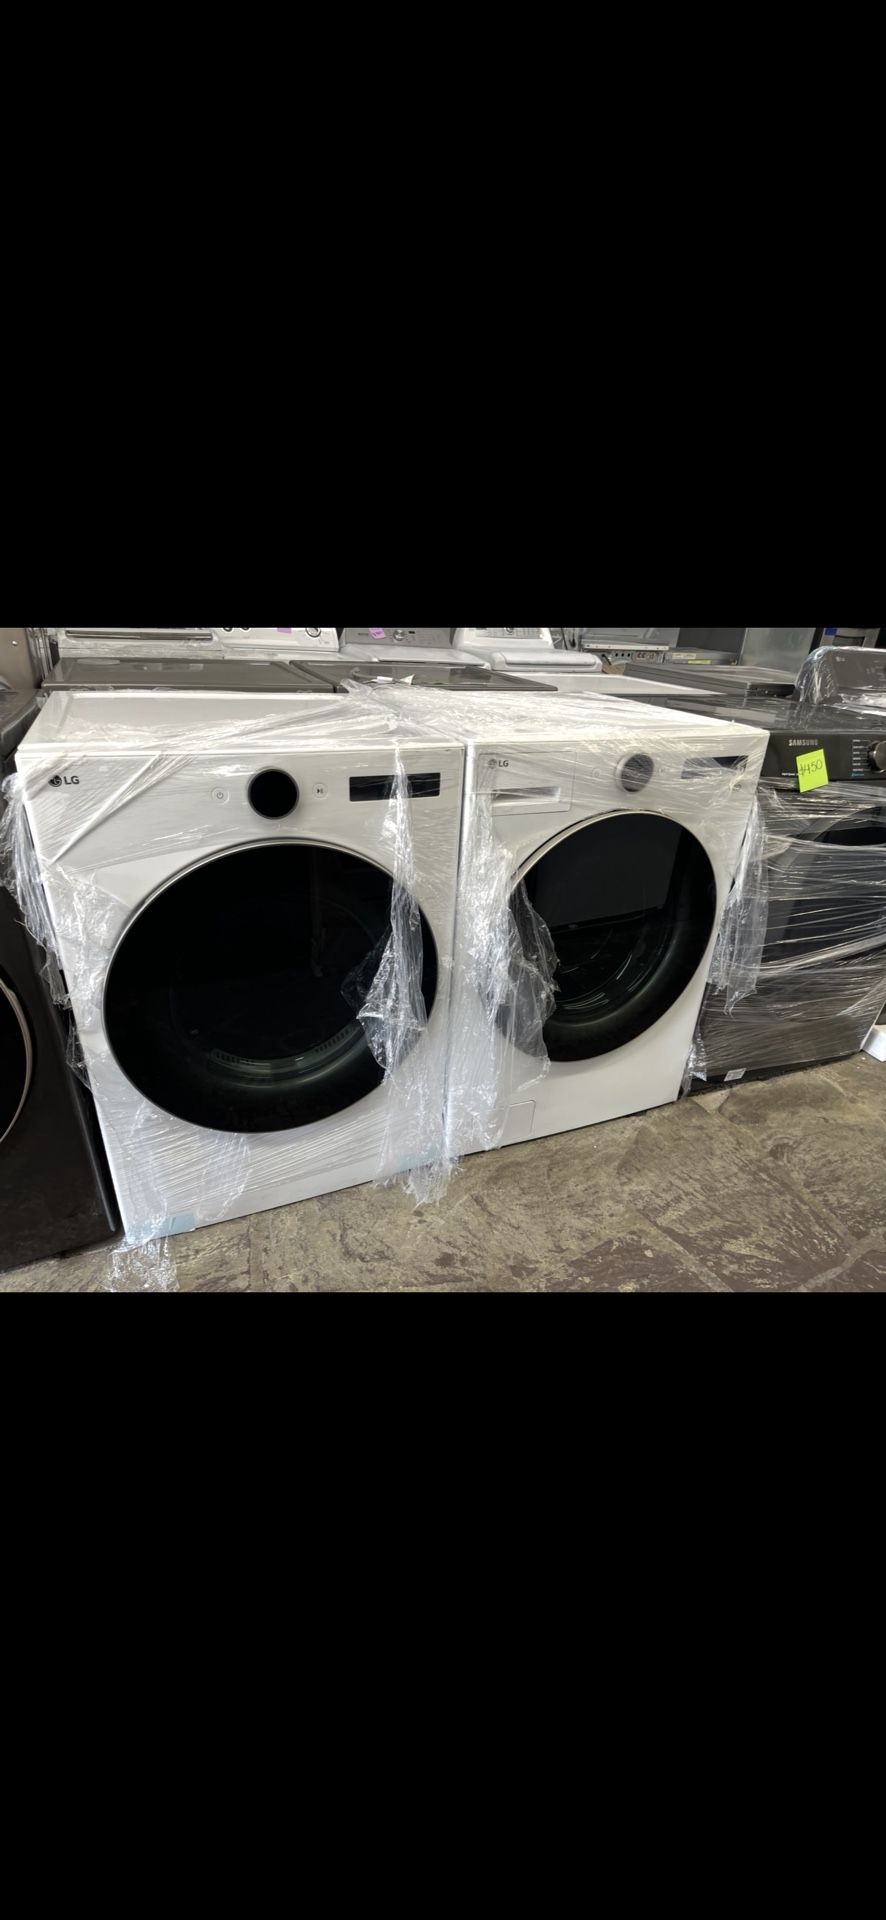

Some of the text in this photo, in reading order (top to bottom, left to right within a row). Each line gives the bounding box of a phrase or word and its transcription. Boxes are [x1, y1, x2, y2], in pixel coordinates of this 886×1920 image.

[788, 739, 819, 747] SAMSUNG
[498, 759, 509, 768] LG
[63, 775, 80, 785] LG
